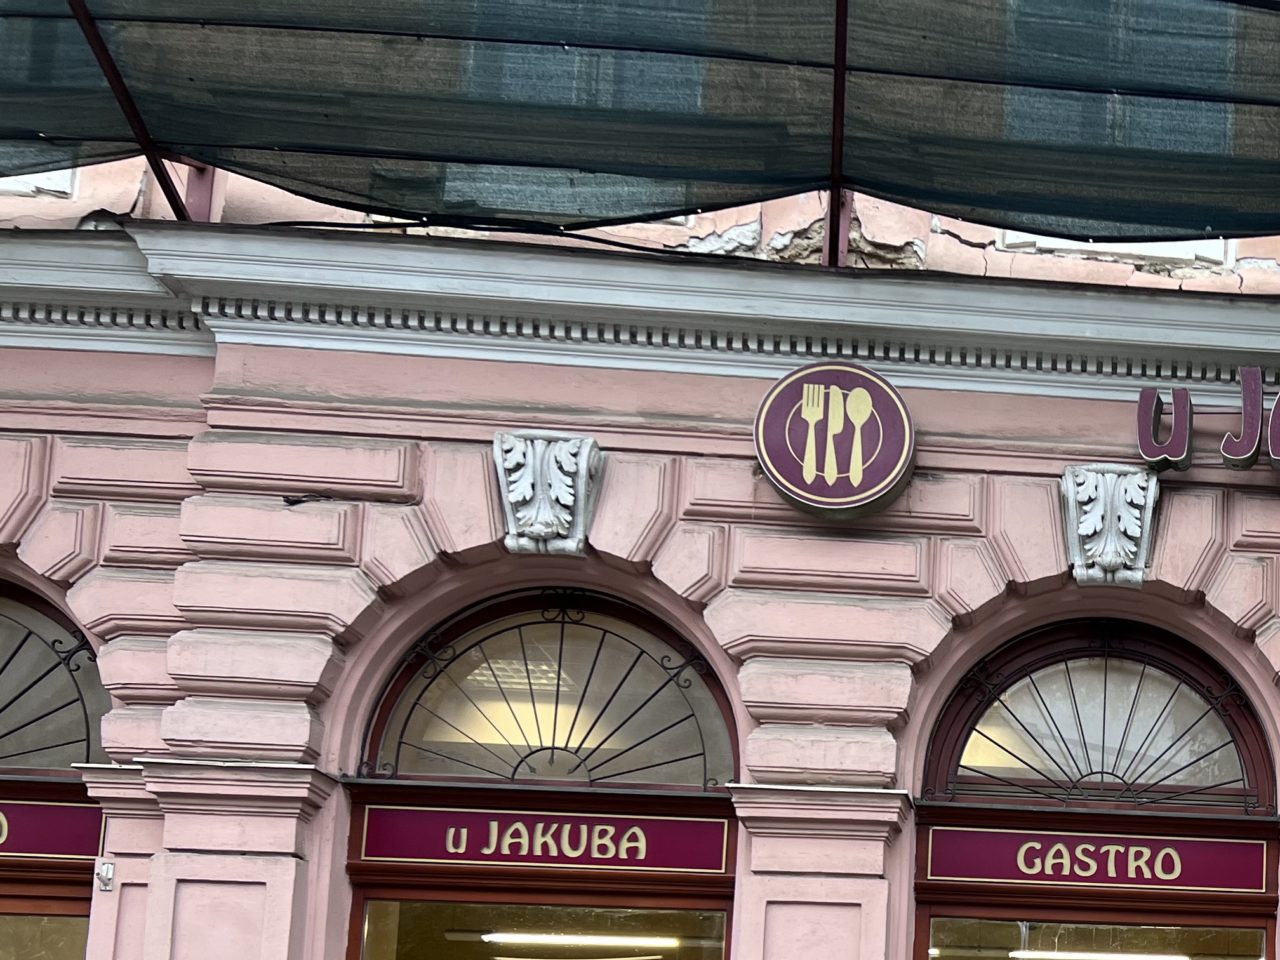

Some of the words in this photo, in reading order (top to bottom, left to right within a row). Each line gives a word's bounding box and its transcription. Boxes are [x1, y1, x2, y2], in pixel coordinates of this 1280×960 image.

[1137, 386, 1193, 468] u
[445, 826, 468, 854] u
[480, 820, 648, 860] JAKUBA
[1016, 841, 1182, 880] GASTRO
